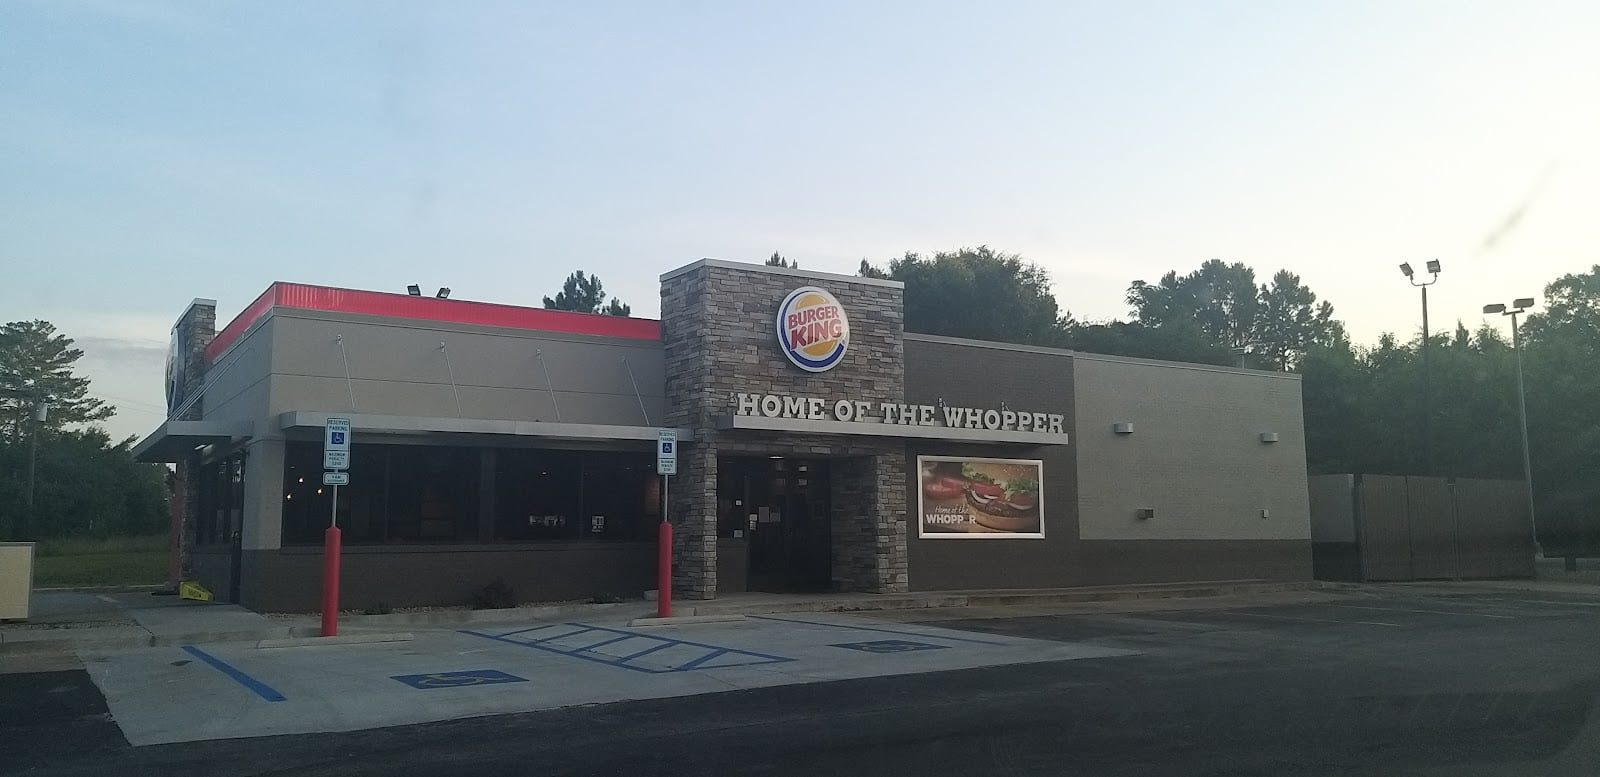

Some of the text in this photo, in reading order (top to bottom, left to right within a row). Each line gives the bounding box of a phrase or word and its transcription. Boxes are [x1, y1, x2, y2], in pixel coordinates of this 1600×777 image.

[788, 305, 839, 330] BURGER
[790, 318, 842, 350] KING
[736, 392, 1065, 434] HOME OF THE WHOPPER
[926, 513, 976, 524] WHOPPR
[935, 505, 950, 513] Home
